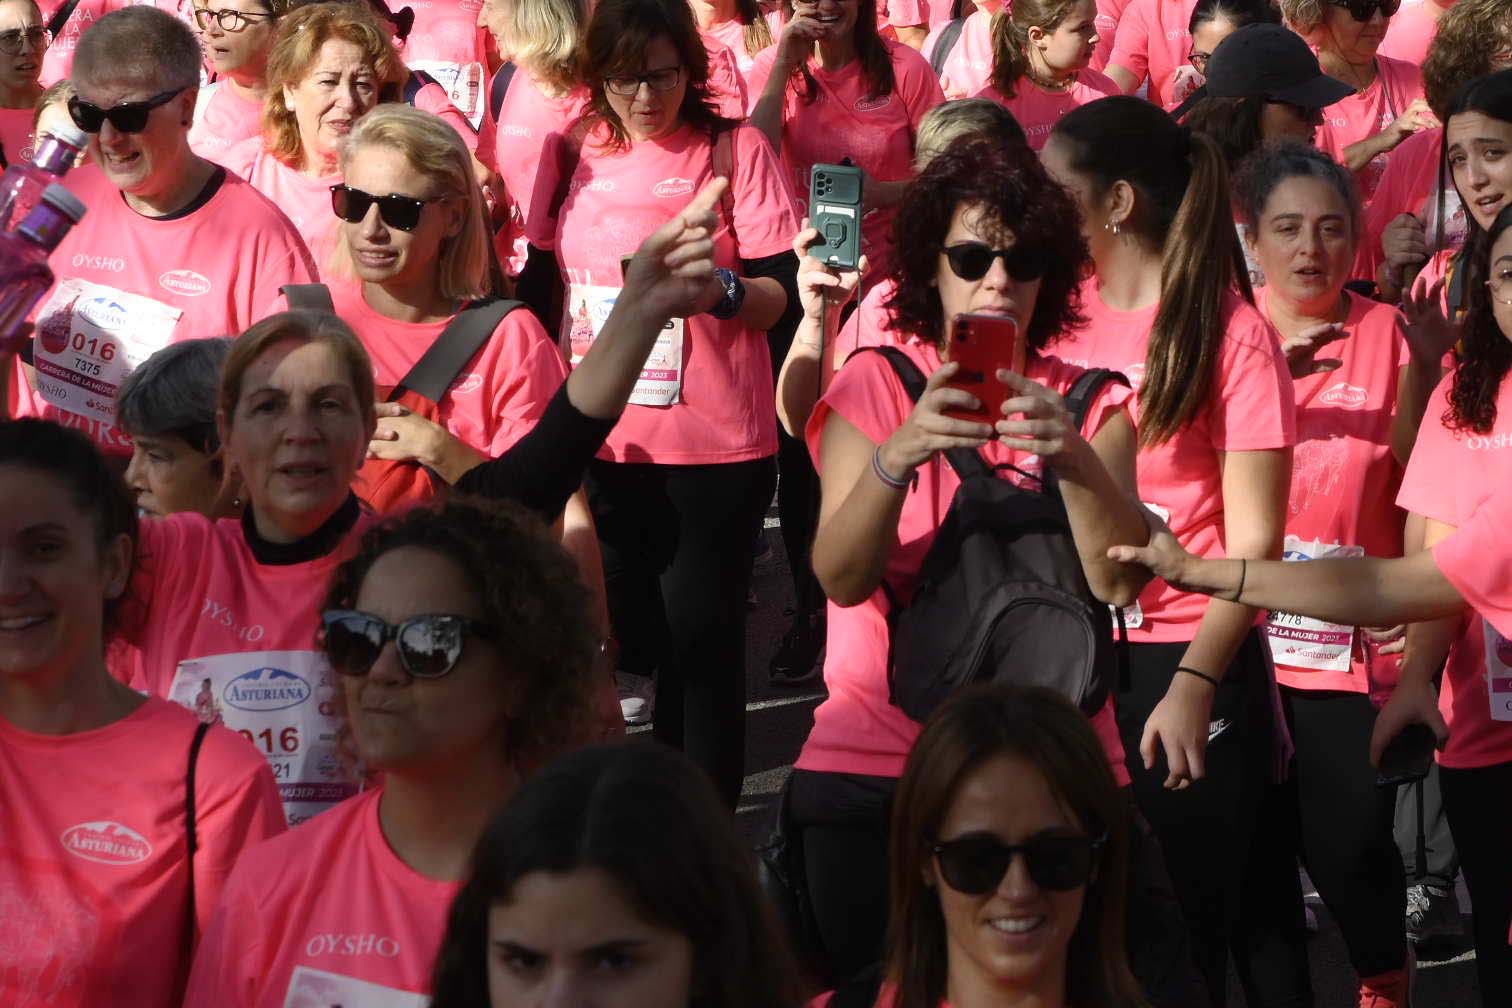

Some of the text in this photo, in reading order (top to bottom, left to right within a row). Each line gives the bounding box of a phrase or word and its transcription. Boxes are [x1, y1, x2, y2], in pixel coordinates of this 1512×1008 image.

[71, 253, 126, 273] OYSHO
[72, 333, 116, 361] 016
[75, 358, 102, 377] 7375
[229, 685, 304, 703] ASTURIANA
[69, 834, 146, 860] ASTURIANA
[306, 932, 401, 959] OYSHO
